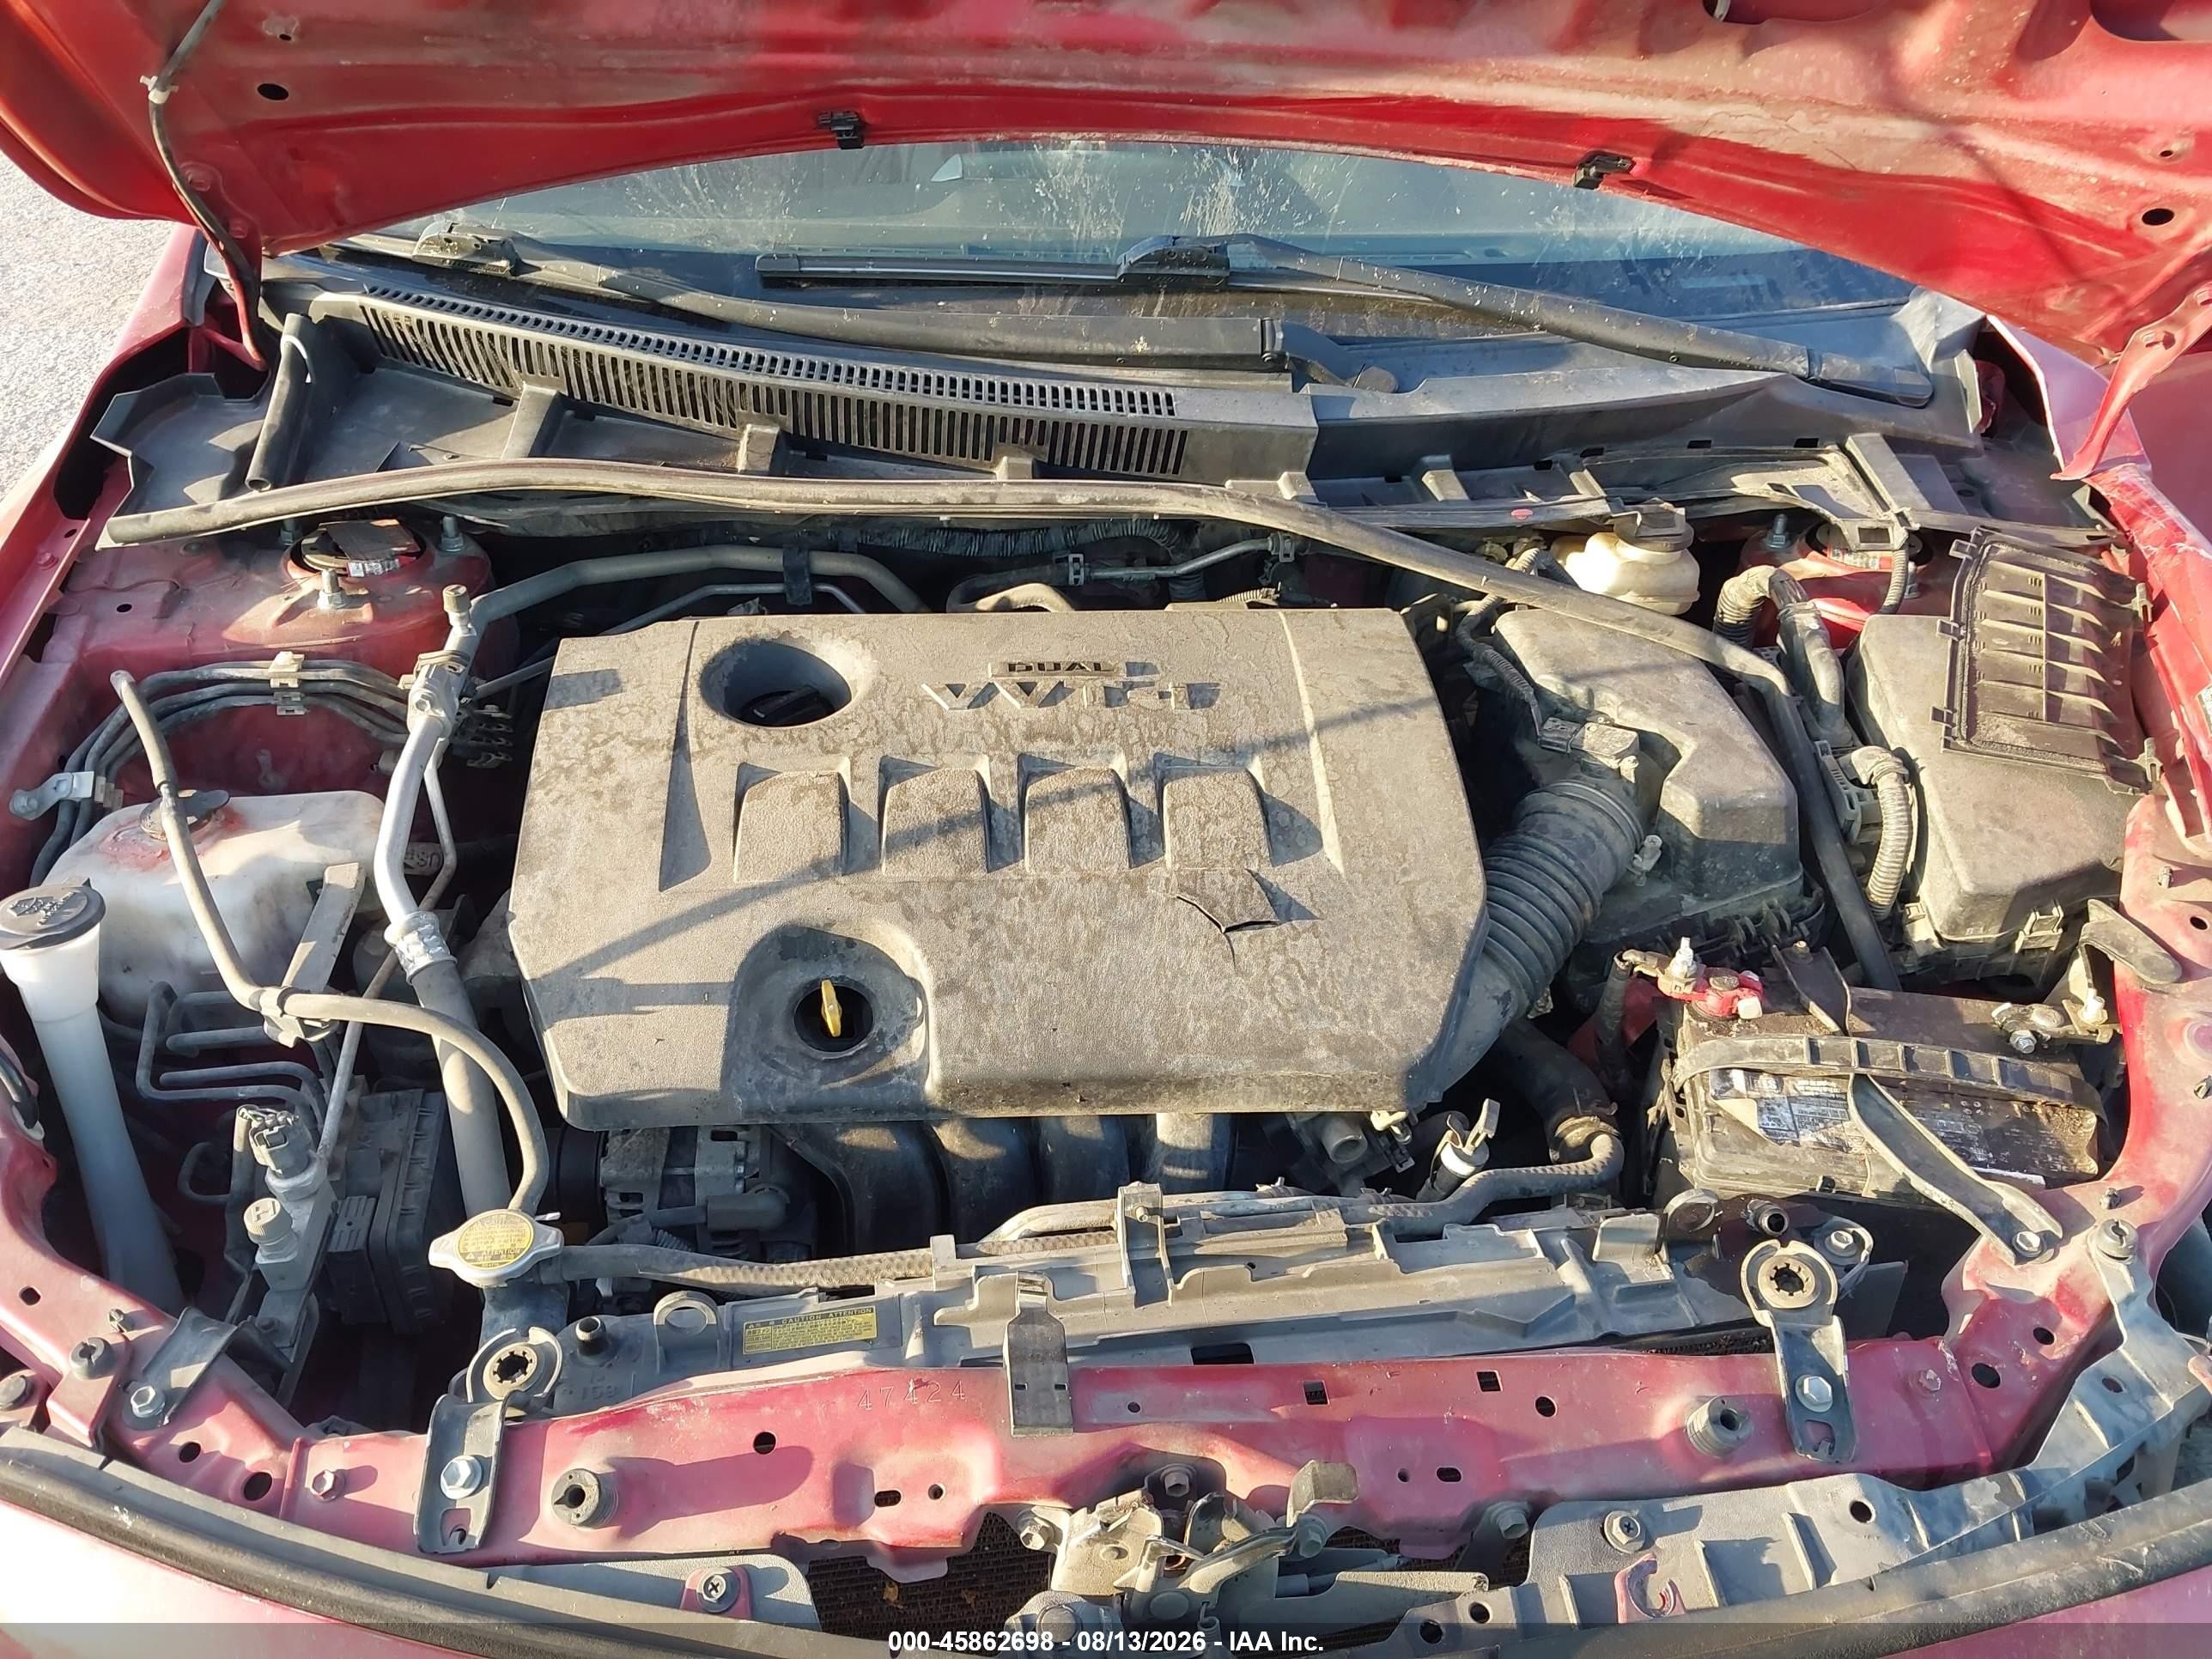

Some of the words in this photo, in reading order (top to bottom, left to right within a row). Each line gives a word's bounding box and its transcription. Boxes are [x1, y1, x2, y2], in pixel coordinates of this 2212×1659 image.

[1007, 661, 1115, 673] DUAL
[781, 1314, 822, 1325] CAUTION
[829, 1308, 872, 1318] ATTENTION
[858, 1378, 967, 1411] 47424
